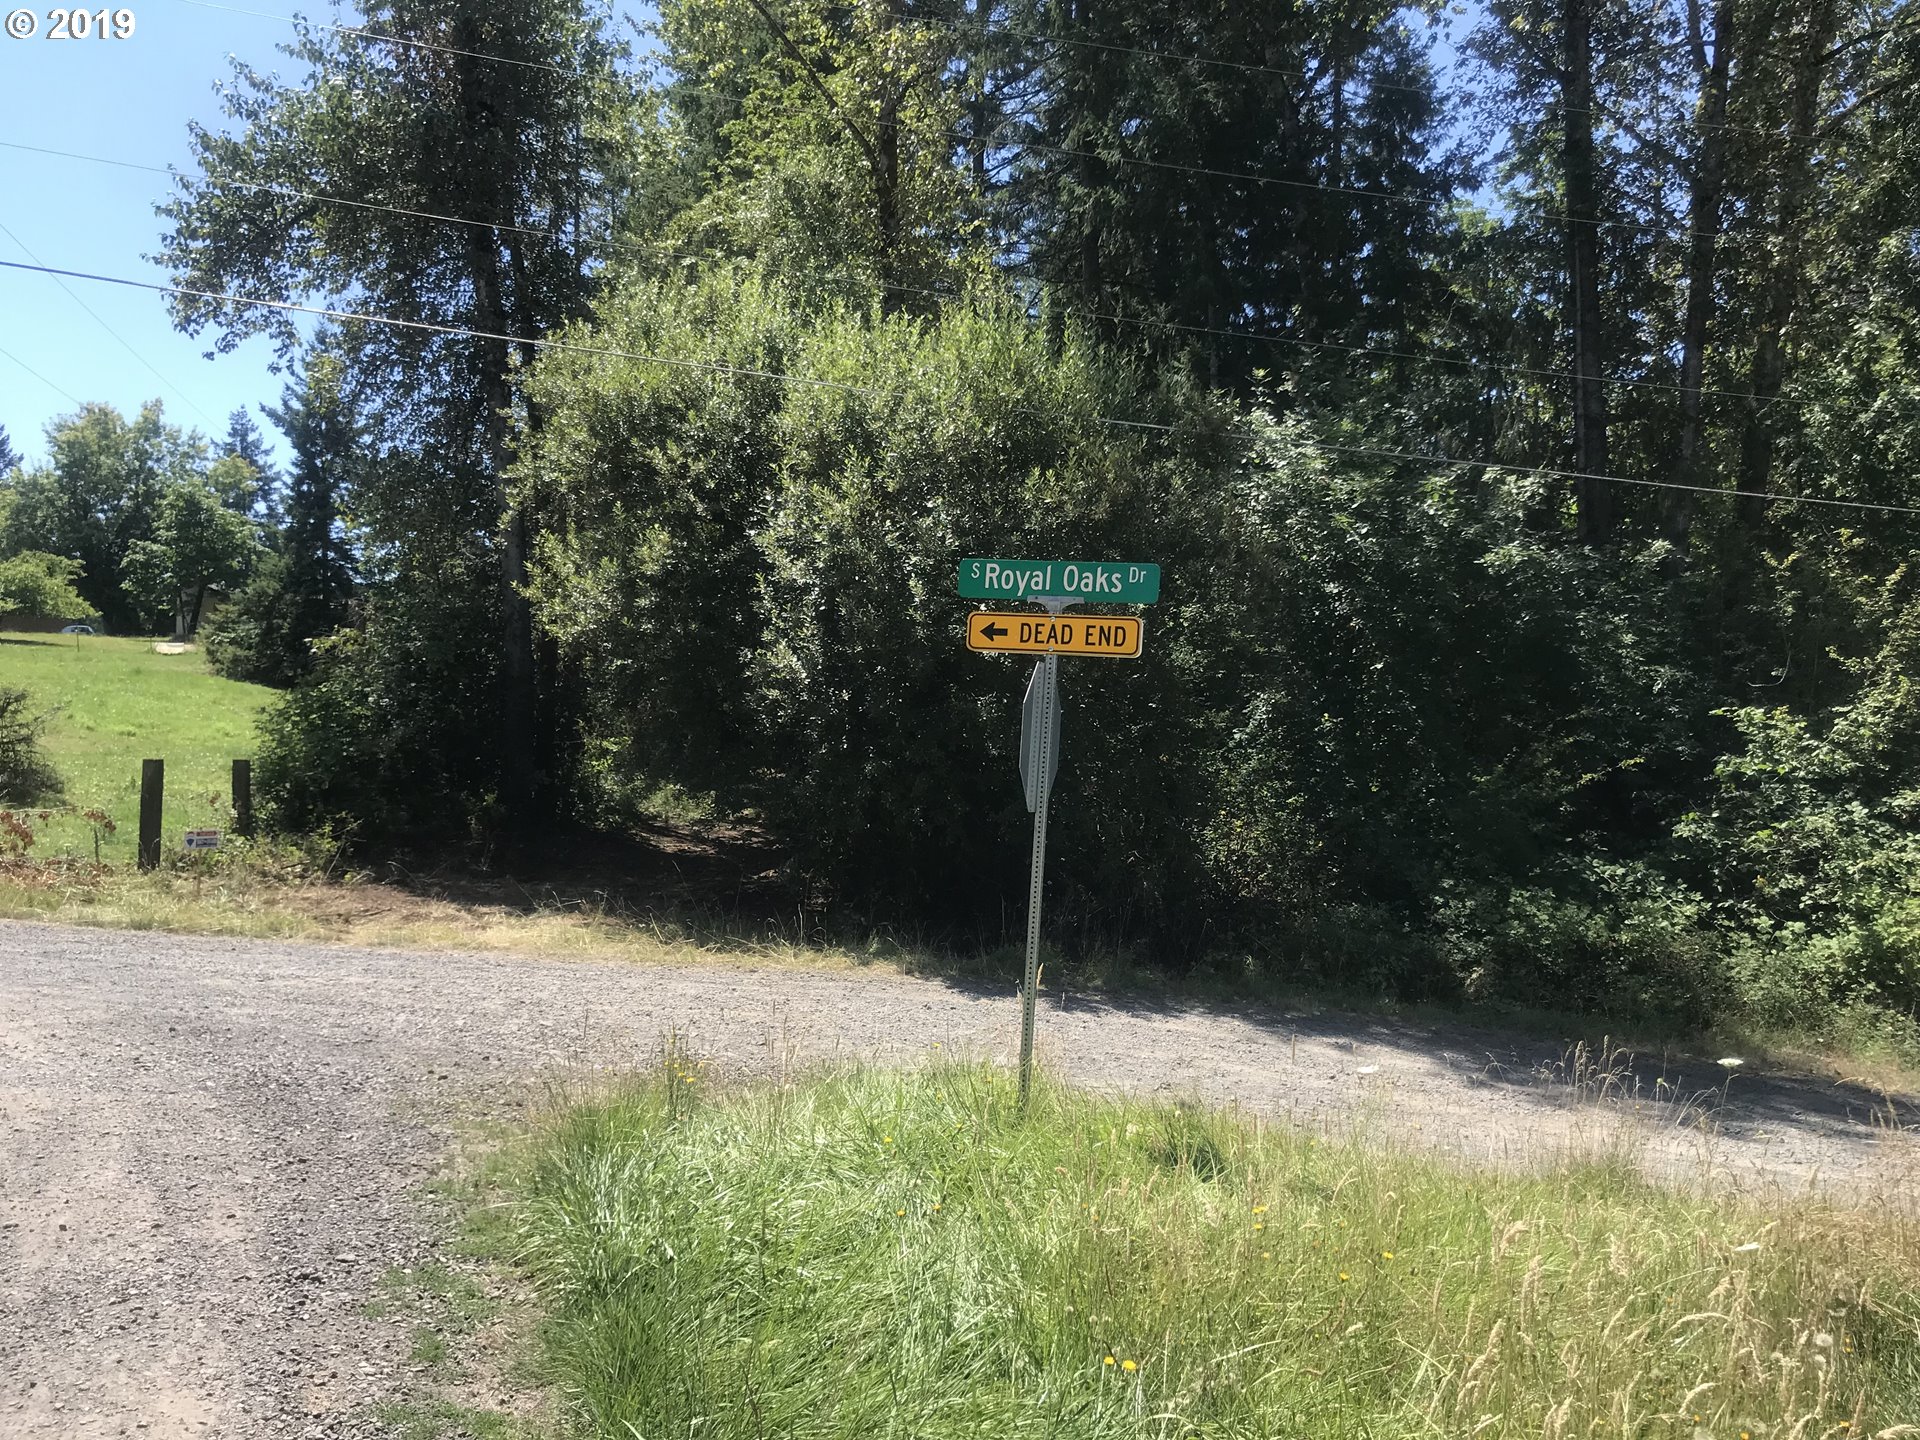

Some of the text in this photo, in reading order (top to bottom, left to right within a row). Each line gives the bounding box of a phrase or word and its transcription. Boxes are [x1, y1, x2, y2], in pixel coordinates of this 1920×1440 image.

[971, 562, 1147, 597] S Royal Oaks Dr
[1019, 622, 1127, 648] DEAD END
